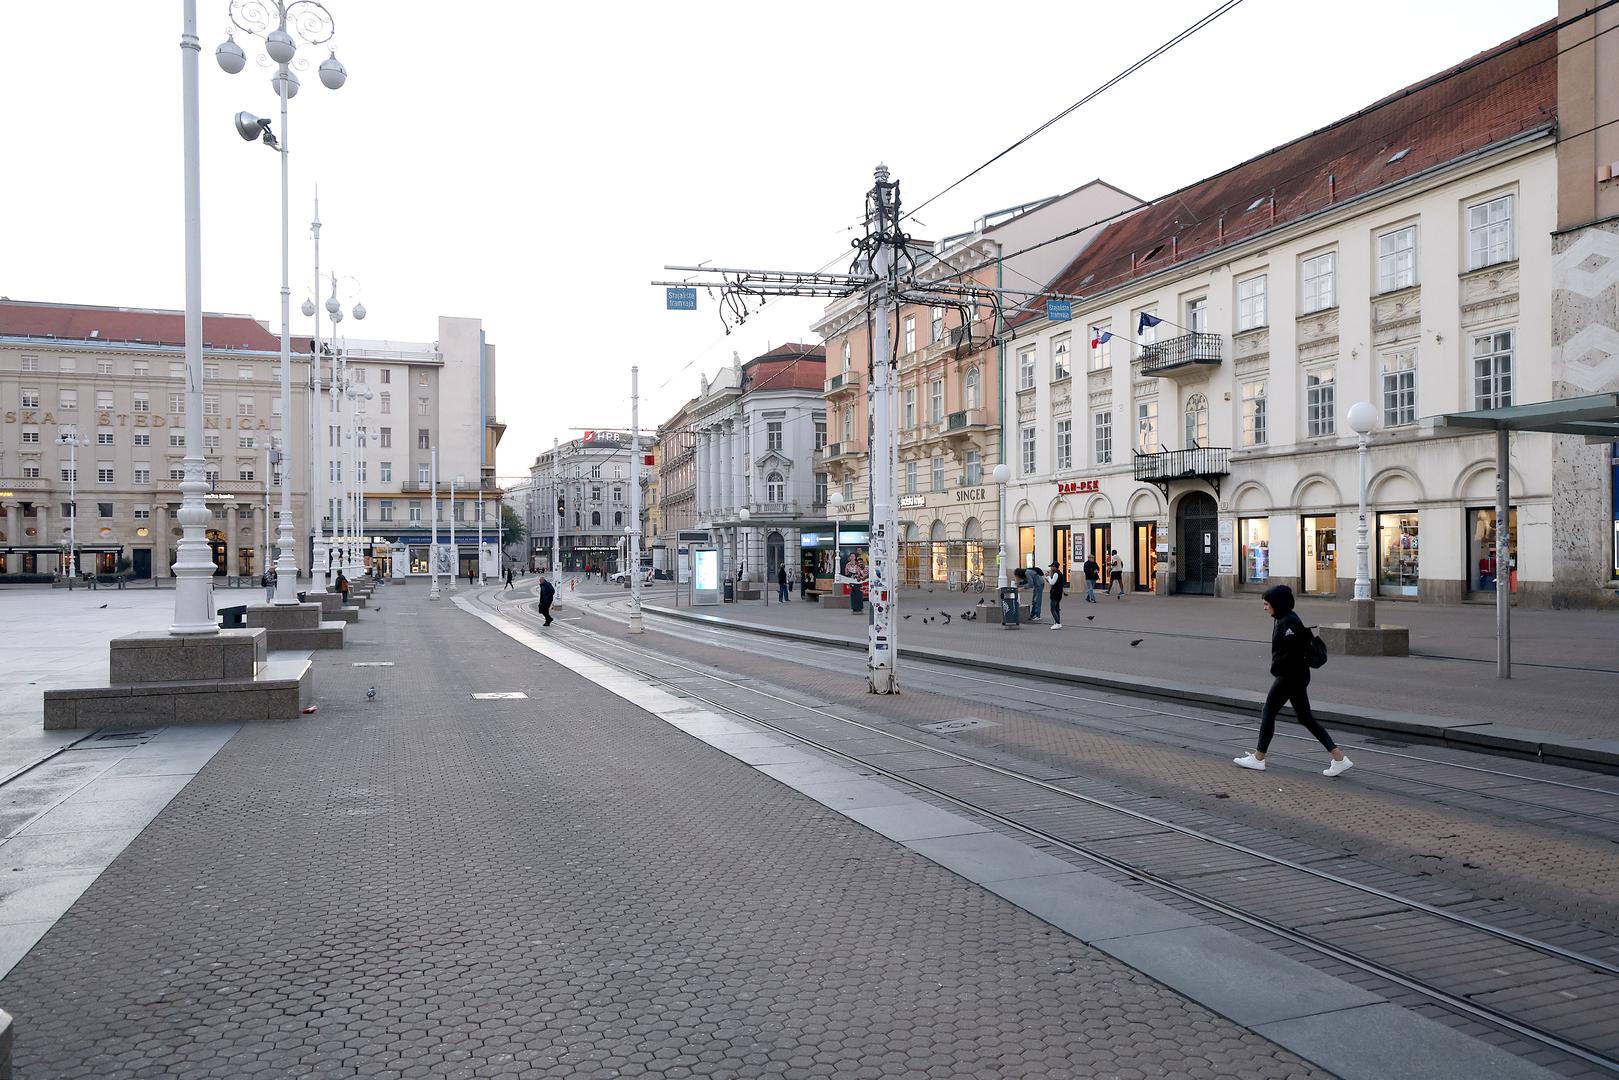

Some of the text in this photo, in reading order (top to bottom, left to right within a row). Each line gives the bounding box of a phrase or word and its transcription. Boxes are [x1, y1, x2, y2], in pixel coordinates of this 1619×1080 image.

[96, 411, 271, 430] ŠTEDINICA
[597, 432, 620, 441] HPB
[1058, 480, 1099, 492] PAN-PEK
[956, 489, 986, 501] SINGER
